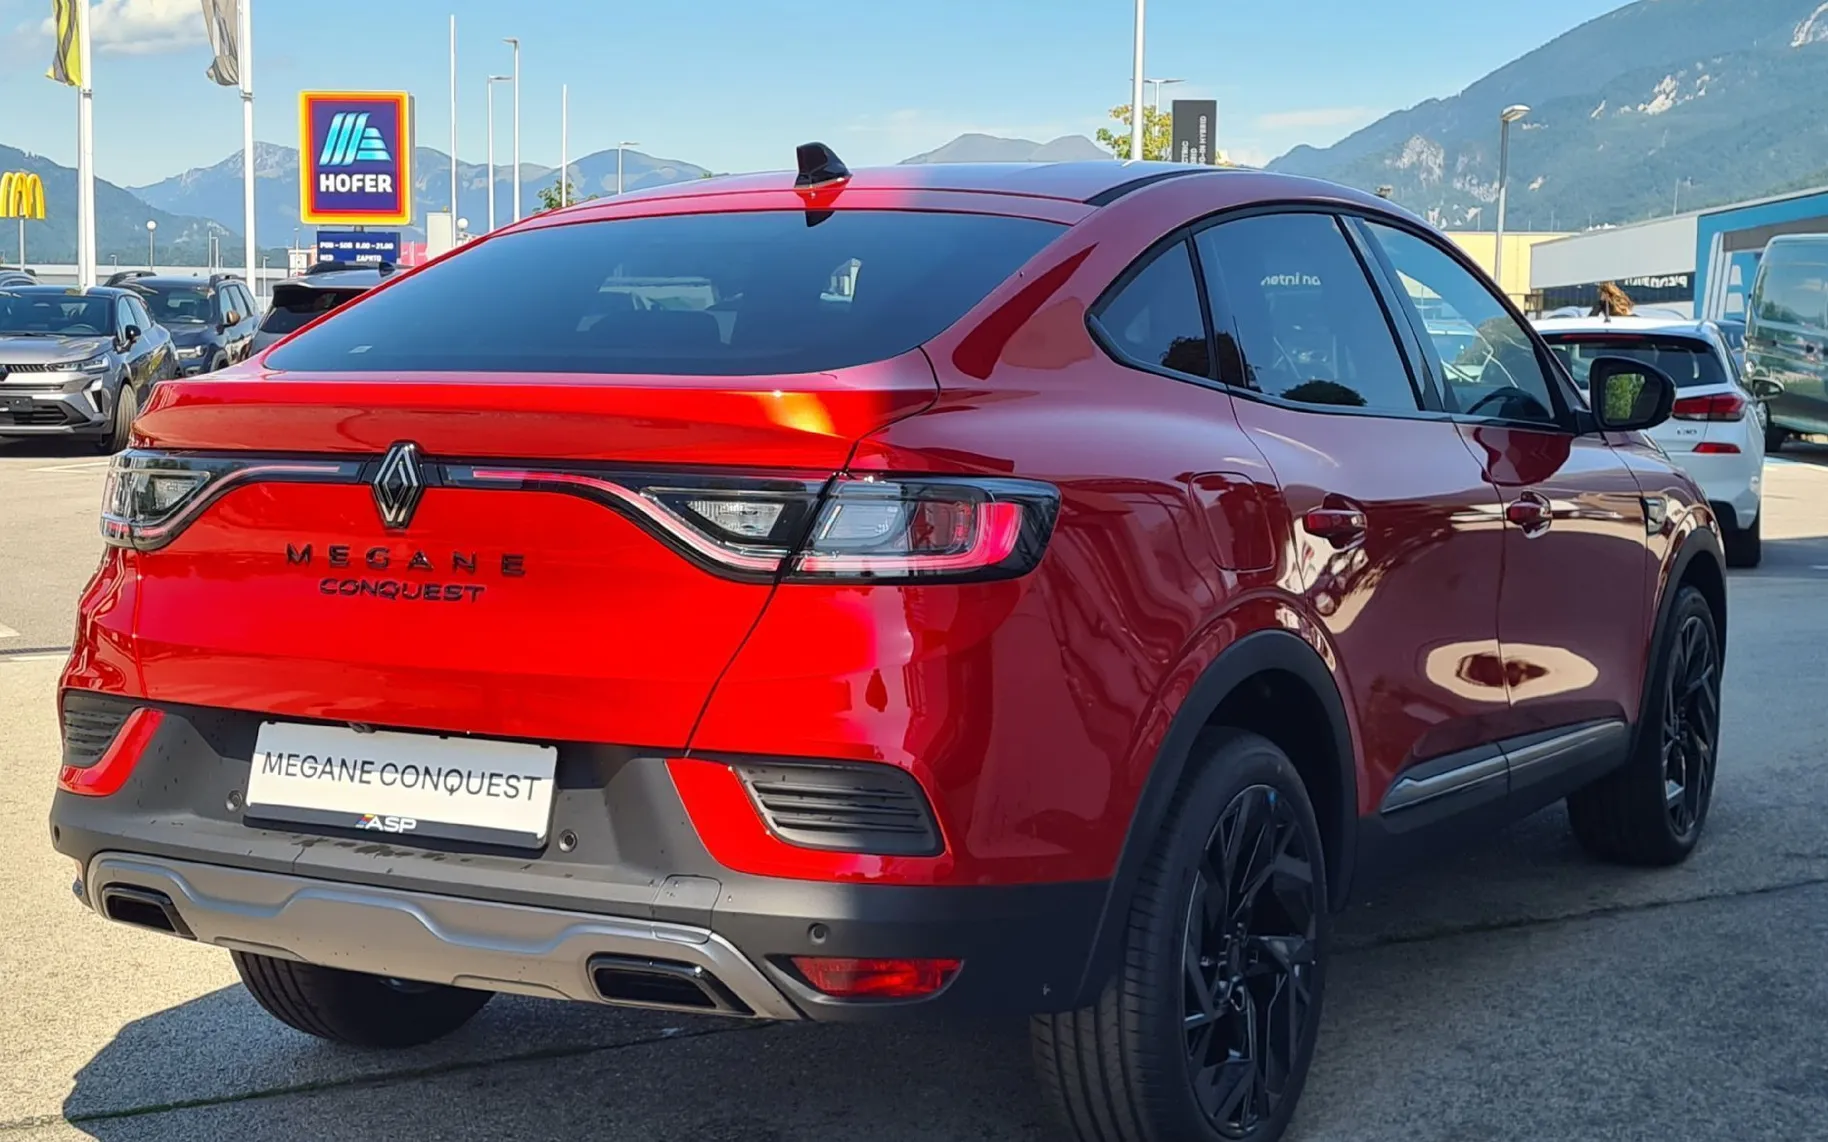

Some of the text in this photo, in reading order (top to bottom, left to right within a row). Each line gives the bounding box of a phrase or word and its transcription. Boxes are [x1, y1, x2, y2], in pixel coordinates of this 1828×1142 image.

[1199, 115, 1207, 144] HYBRID
[320, 173, 393, 193] HOFER
[285, 542, 527, 577] MEGANE
[319, 577, 486, 603] CONQUEST
[262, 751, 542, 801] MEGANE CONQUEST
[364, 815, 418, 834] ASP
